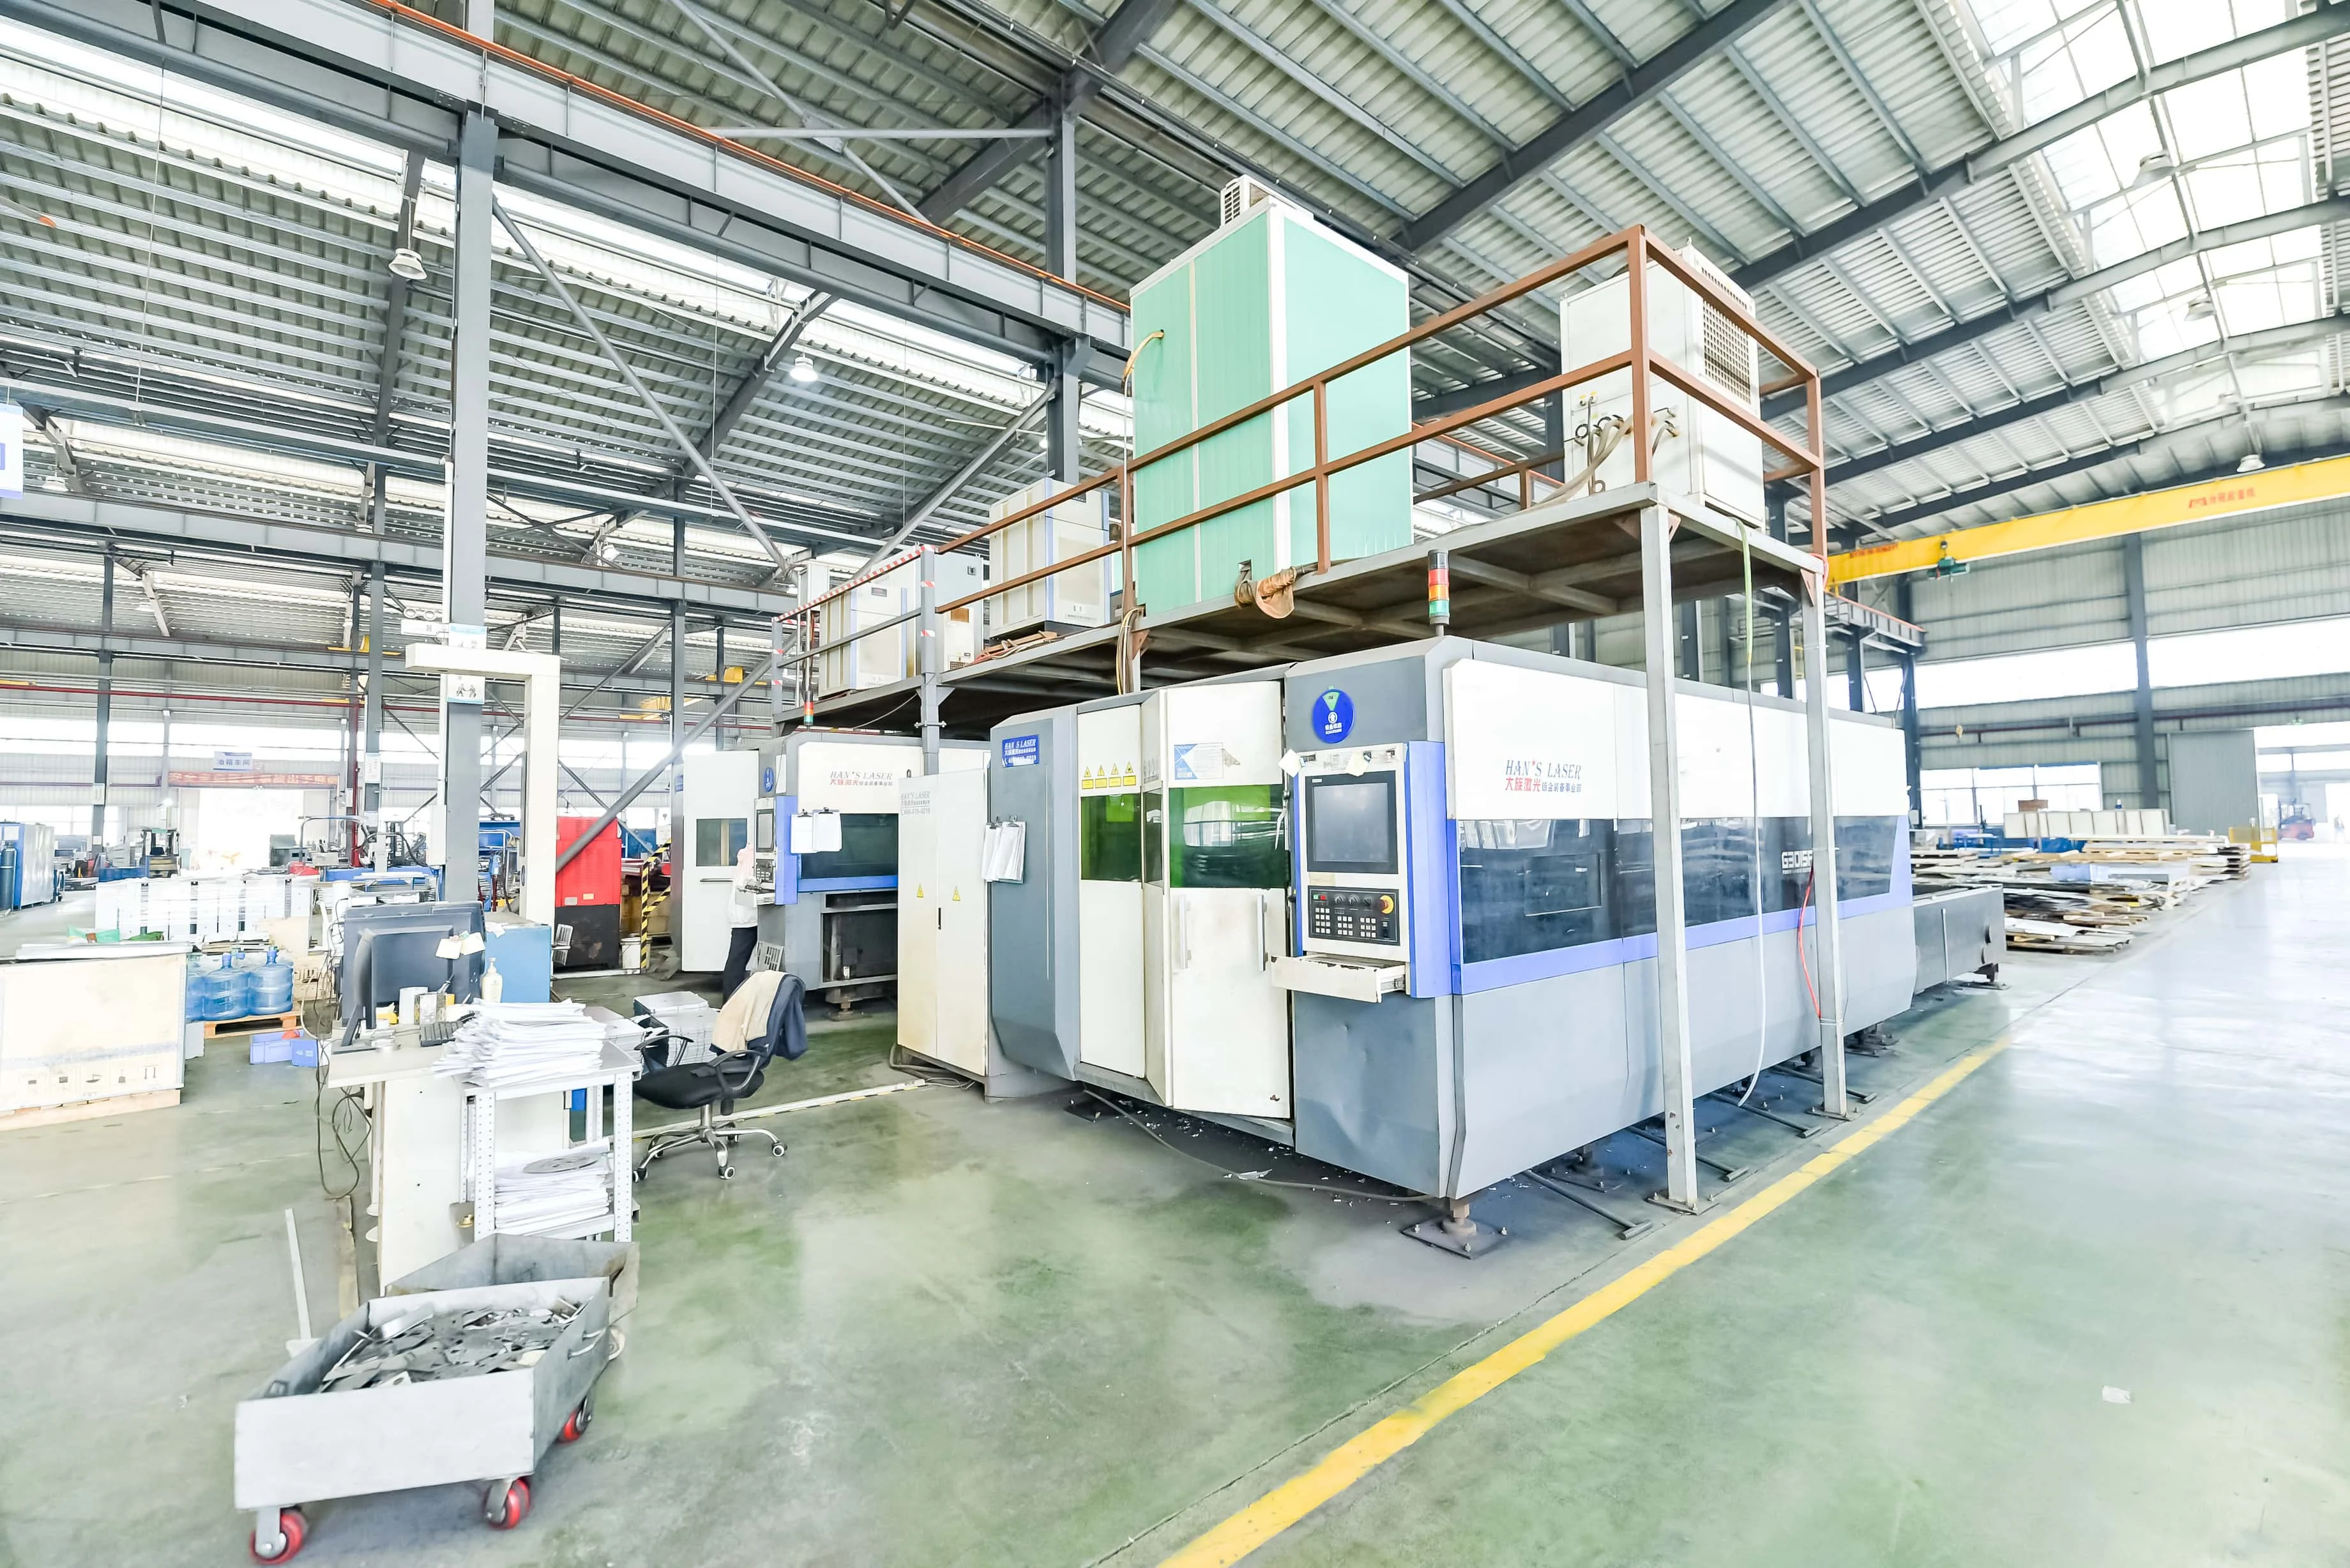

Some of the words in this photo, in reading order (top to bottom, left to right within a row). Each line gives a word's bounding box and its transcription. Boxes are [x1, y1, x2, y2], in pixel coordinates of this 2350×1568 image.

[863, 771, 893, 780] LASER
[1505, 758, 1543, 777] HAN'S
[1547, 762, 1582, 780] LASER
